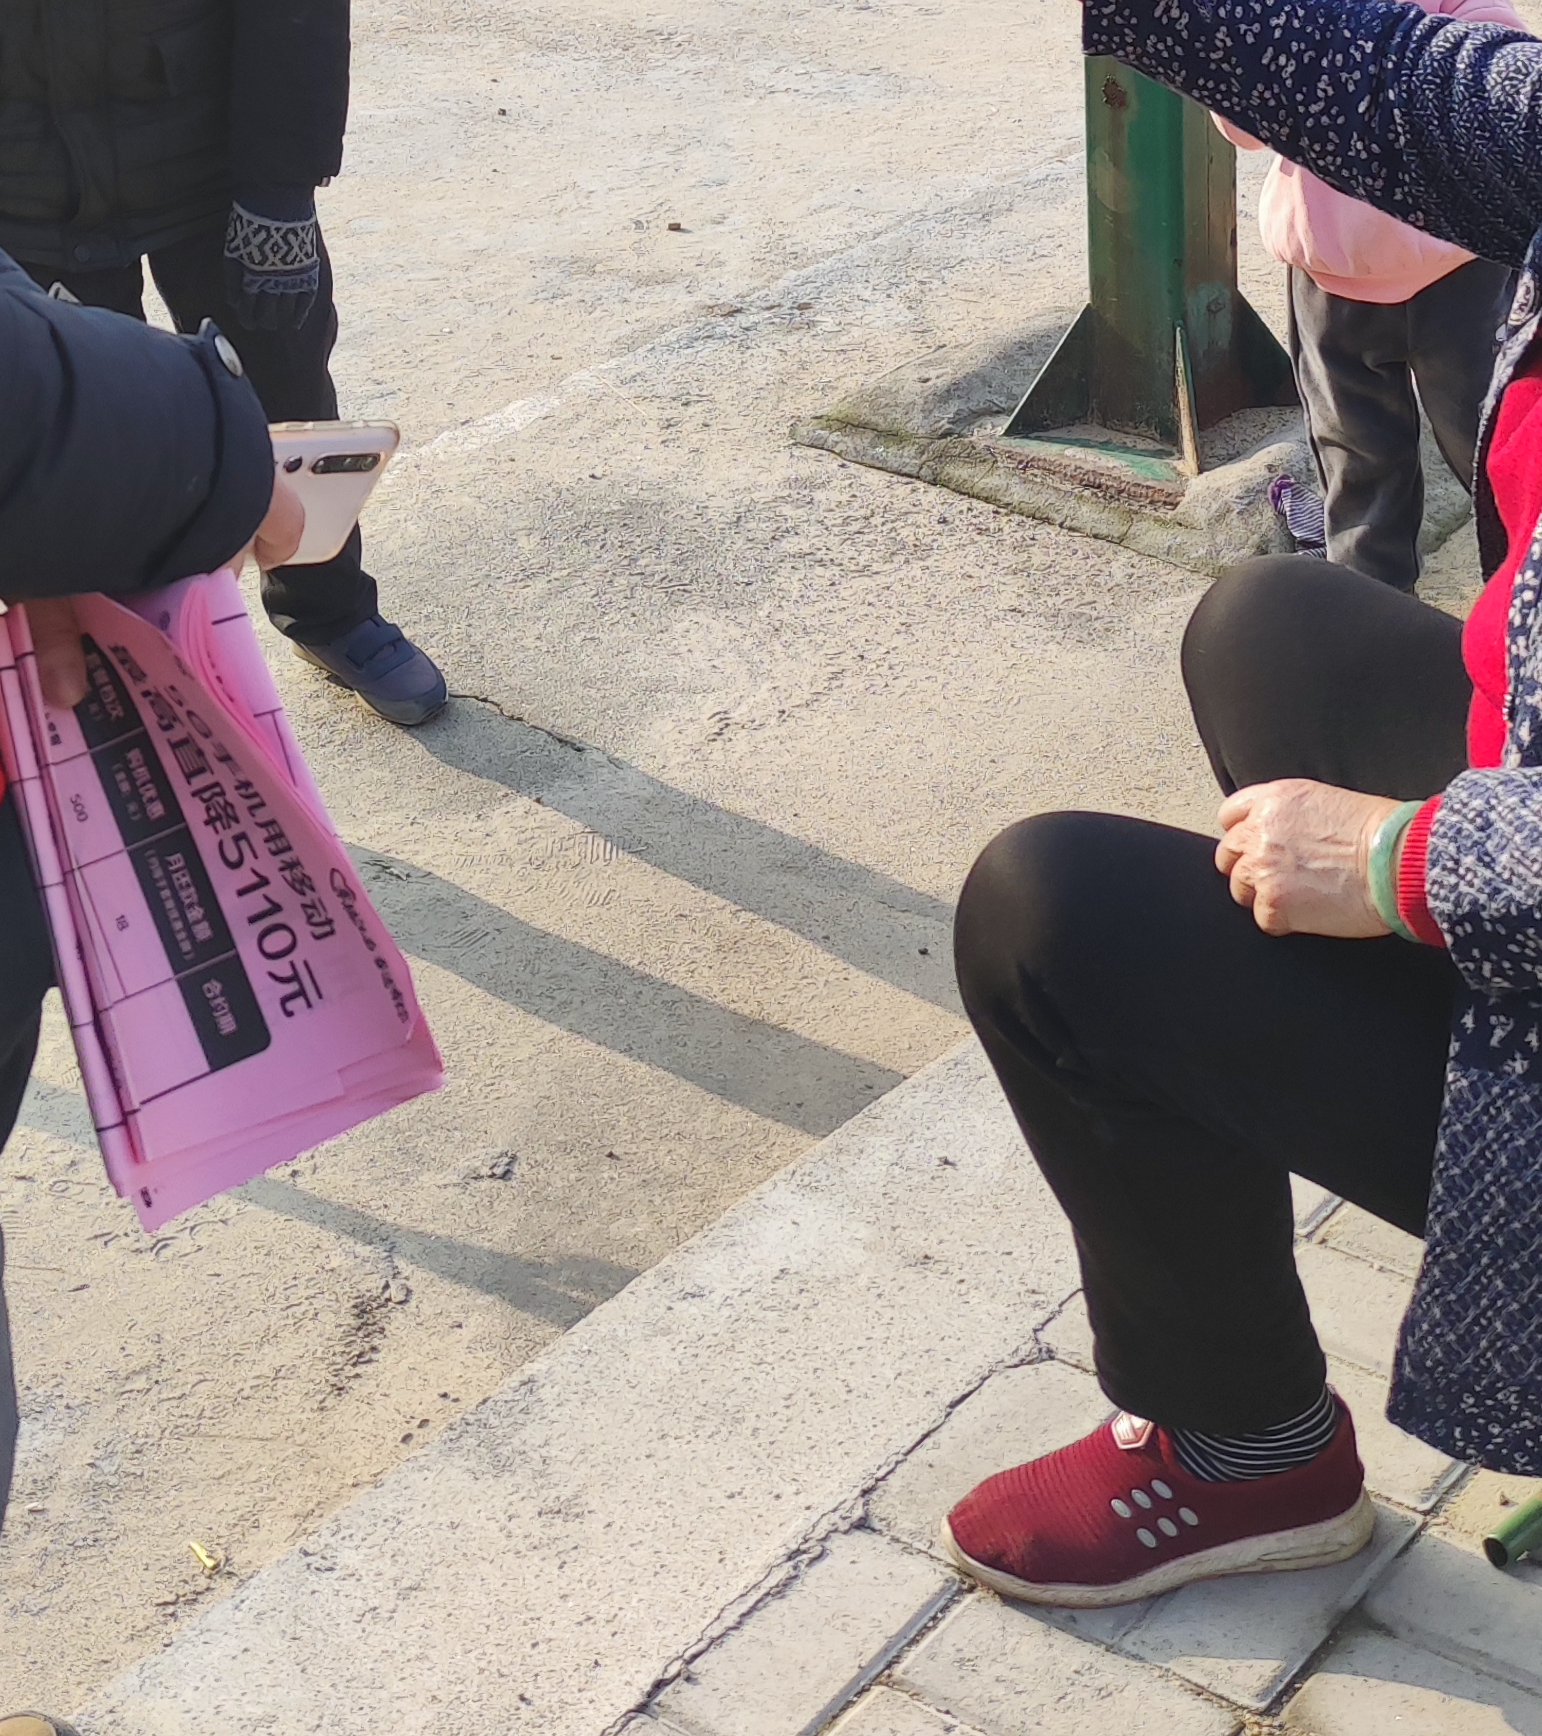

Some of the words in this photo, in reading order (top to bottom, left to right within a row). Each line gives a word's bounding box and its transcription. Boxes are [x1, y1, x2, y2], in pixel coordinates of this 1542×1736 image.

[69, 793, 89, 824] 500
[107, 644, 323, 1018] 最高直降5110元
[164, 684, 337, 942] 5G手机用移动
